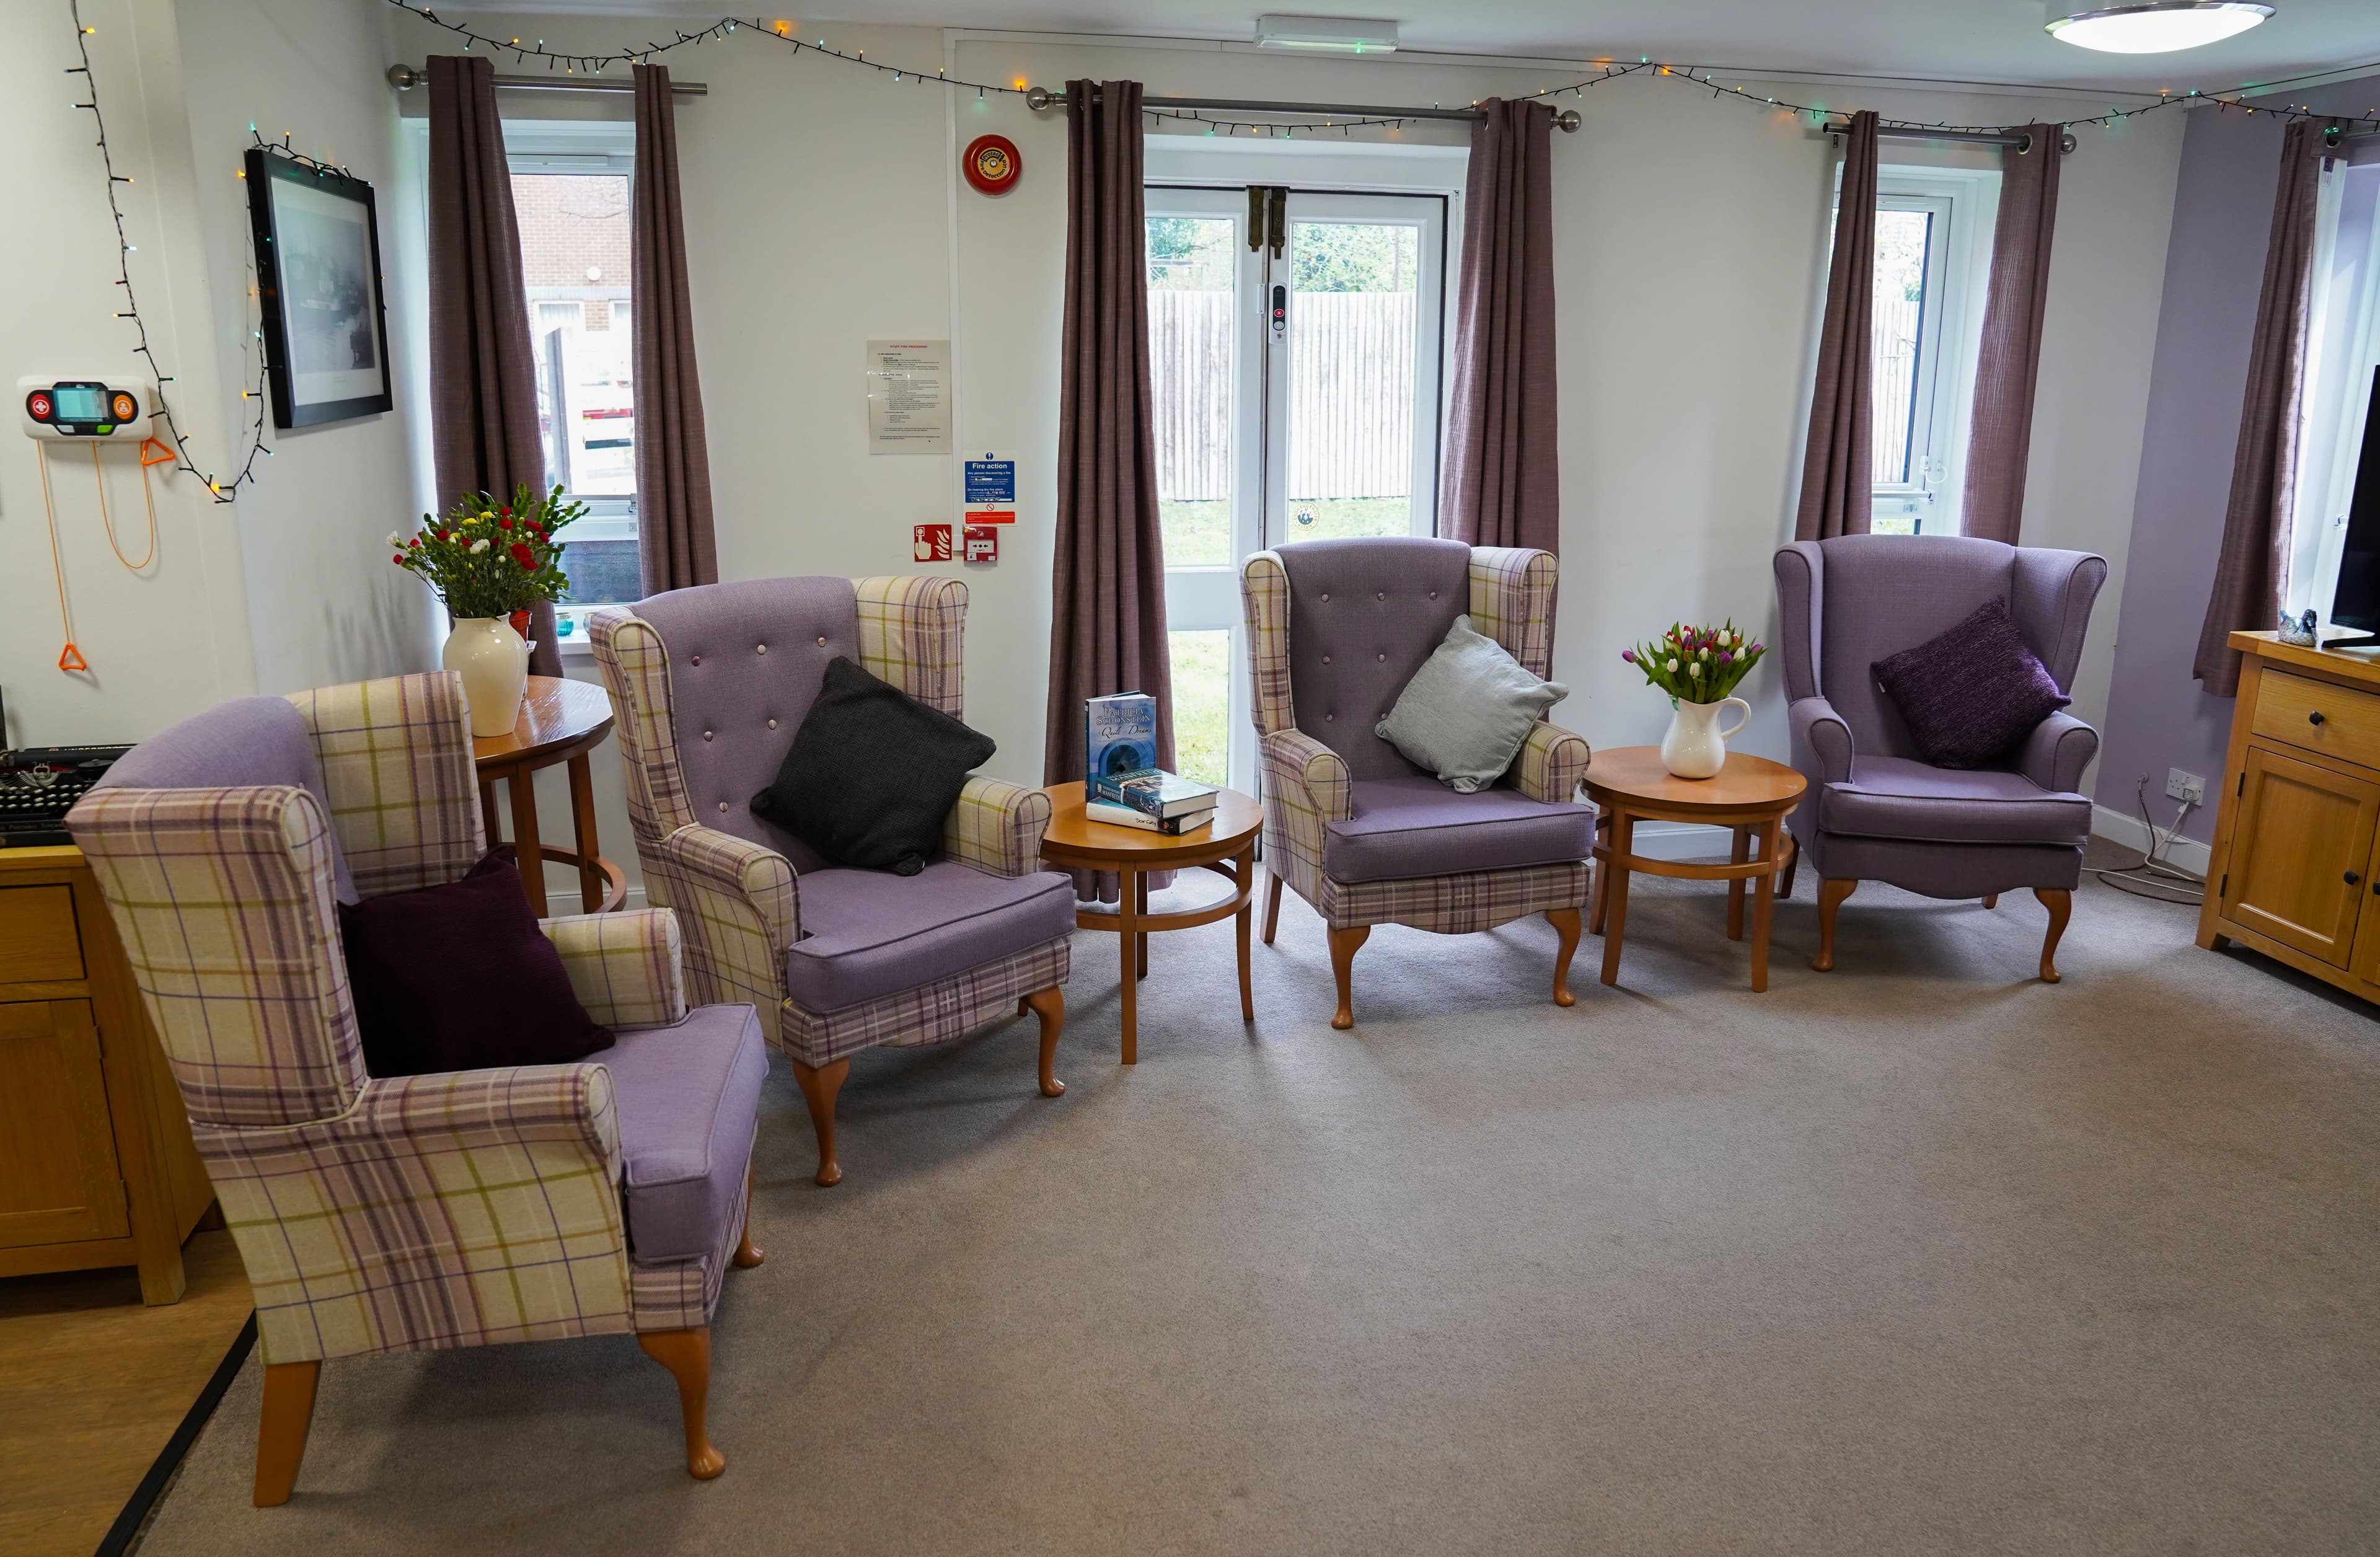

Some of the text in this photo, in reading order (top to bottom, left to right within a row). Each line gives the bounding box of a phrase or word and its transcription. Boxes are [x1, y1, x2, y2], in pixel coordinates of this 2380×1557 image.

[983, 169, 1005, 178] Detection
[1104, 707, 1144, 717] PATRICIA
[1096, 715, 1150, 725] SCHONSTEIN
[1102, 726, 1121, 739] Quilt
[1129, 725, 1152, 734] Dreams
